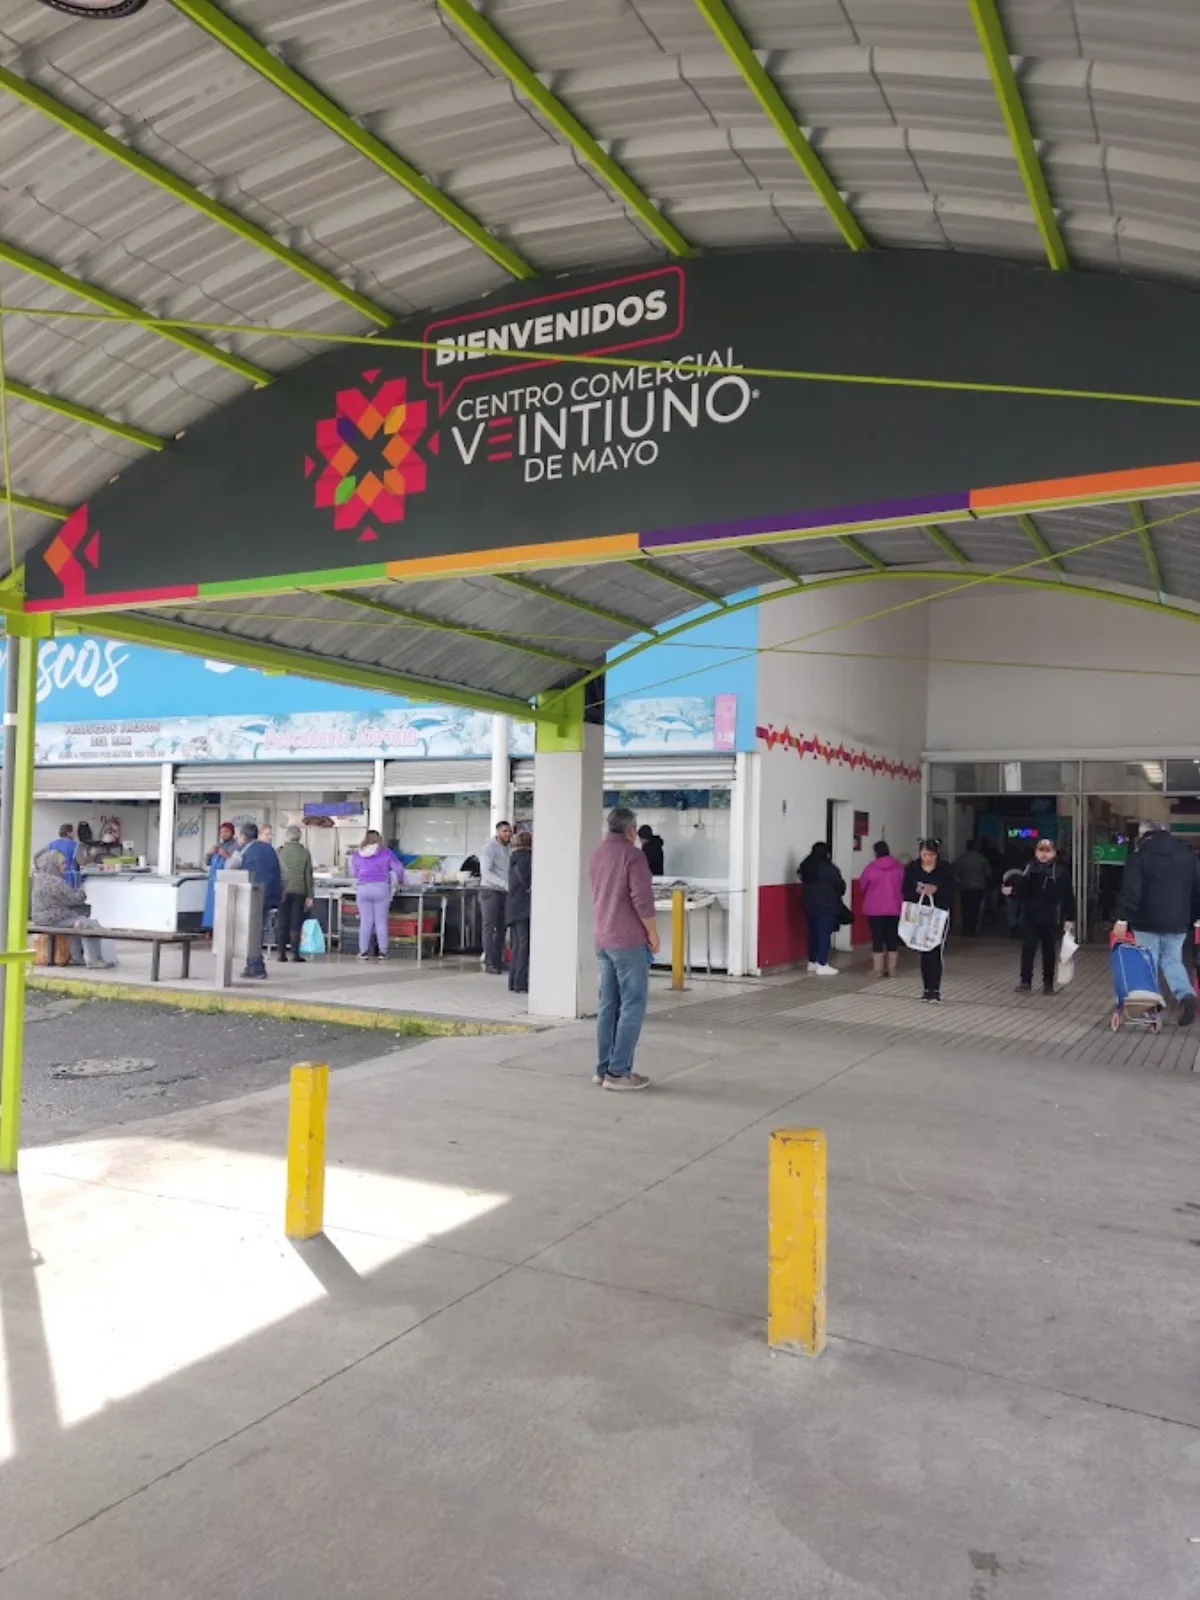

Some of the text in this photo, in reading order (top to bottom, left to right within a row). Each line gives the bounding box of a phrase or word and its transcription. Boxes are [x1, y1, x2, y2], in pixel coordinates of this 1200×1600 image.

[435, 288, 668, 366] BIENVENIDOS
[451, 375, 751, 465] VEINTIUNO
[456, 346, 744, 422] CENTRO COMERCIAL
[523, 439, 659, 483] DE MAYO
